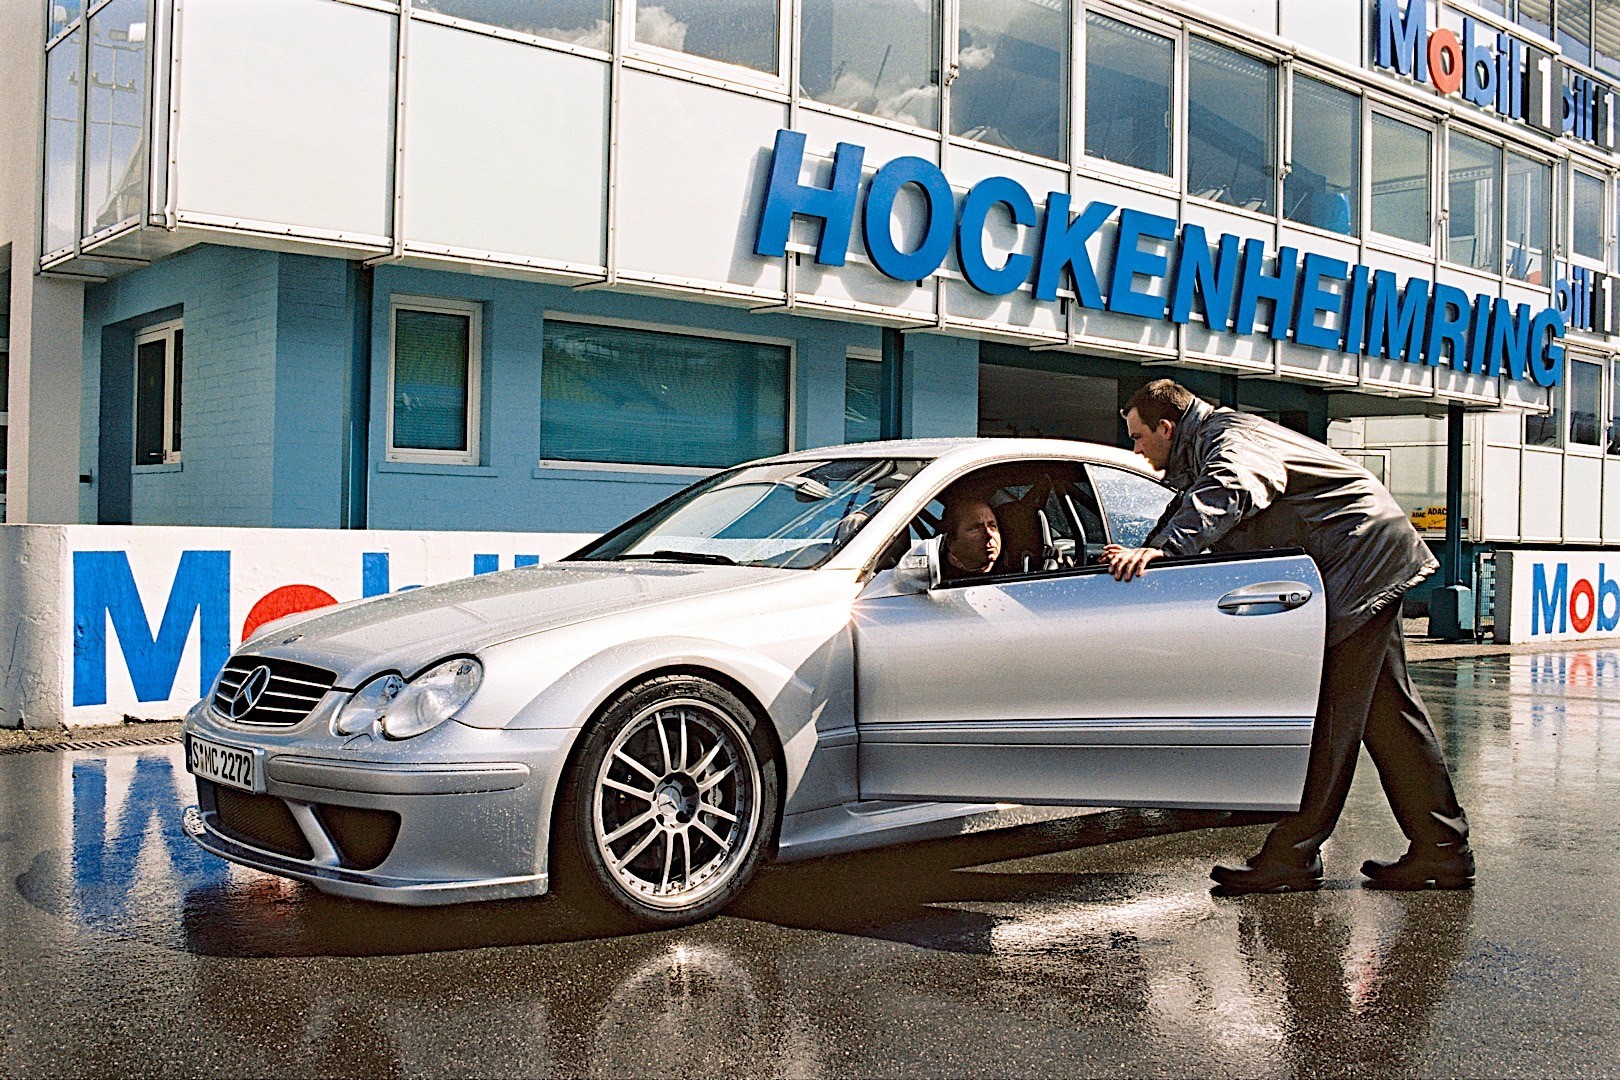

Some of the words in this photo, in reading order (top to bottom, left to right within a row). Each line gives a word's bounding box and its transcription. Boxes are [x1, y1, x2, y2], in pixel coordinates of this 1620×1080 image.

[1376, 0, 1521, 120] Mobil
[753, 128, 1565, 388] HOCKENHEIMRING
[1428, 507, 1447, 516] ADAC
[1531, 562, 1620, 636] Mob
[221, 750, 252, 787] 2272
